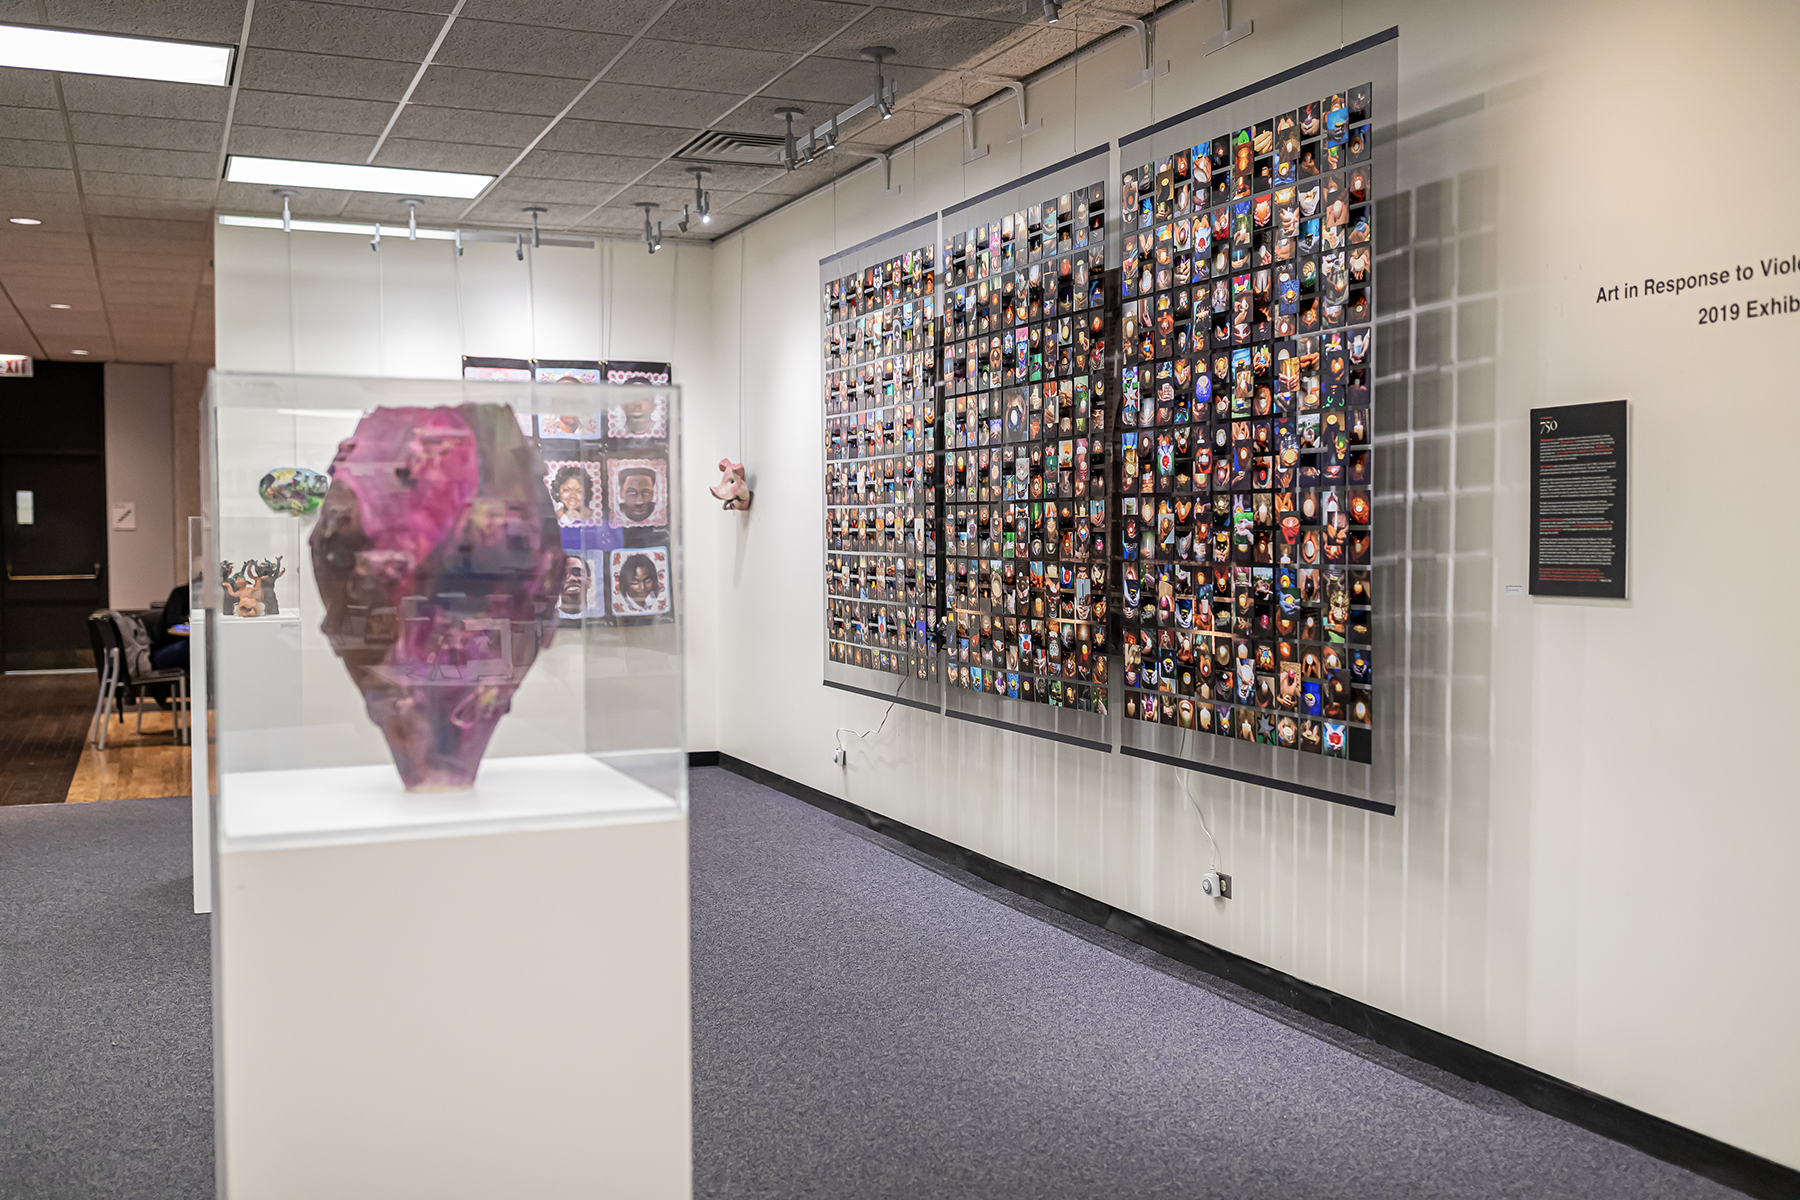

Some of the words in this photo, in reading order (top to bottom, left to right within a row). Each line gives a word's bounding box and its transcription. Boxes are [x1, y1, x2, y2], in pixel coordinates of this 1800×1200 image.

[1596, 286, 1619, 303] Art
[1624, 282, 1638, 299] in
[1644, 270, 1730, 296] Response
[1736, 265, 1754, 281] to
[1760, 254, 1800, 277] Viol
[1698, 303, 1740, 325] 2019
[1747, 295, 1800, 318] Exhib
[1540, 420, 1558, 434] 750
